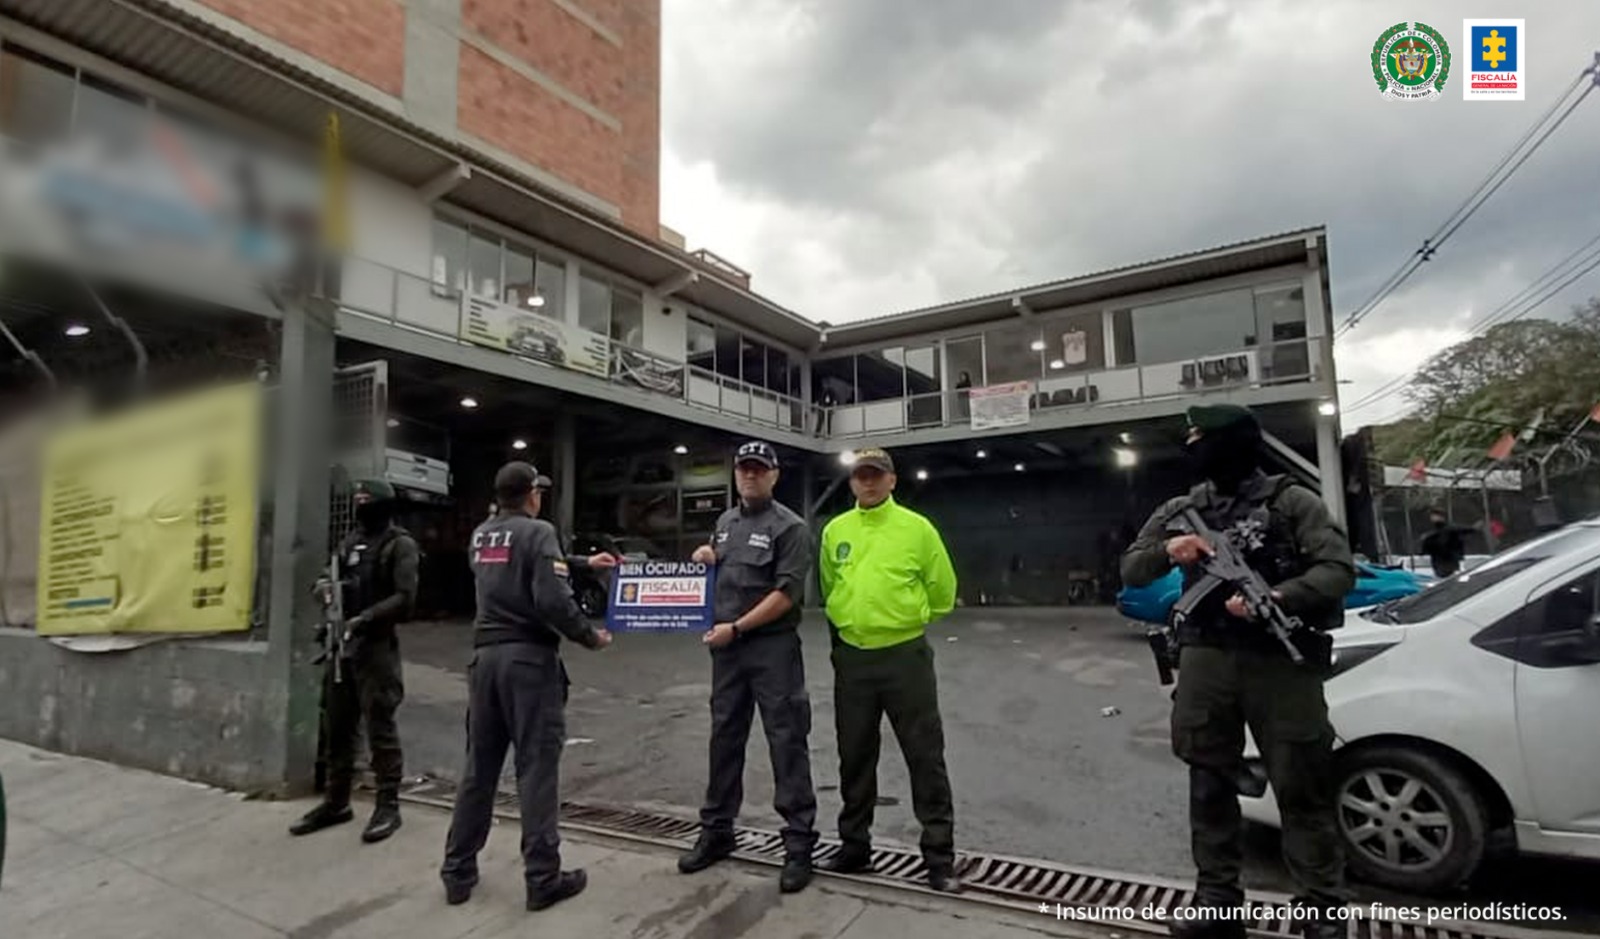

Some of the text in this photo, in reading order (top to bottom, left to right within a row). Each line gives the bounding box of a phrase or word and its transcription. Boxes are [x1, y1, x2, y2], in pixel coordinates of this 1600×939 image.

[739, 442, 765, 455] CTI
[619, 562, 706, 575] BIEN OCUPADO
